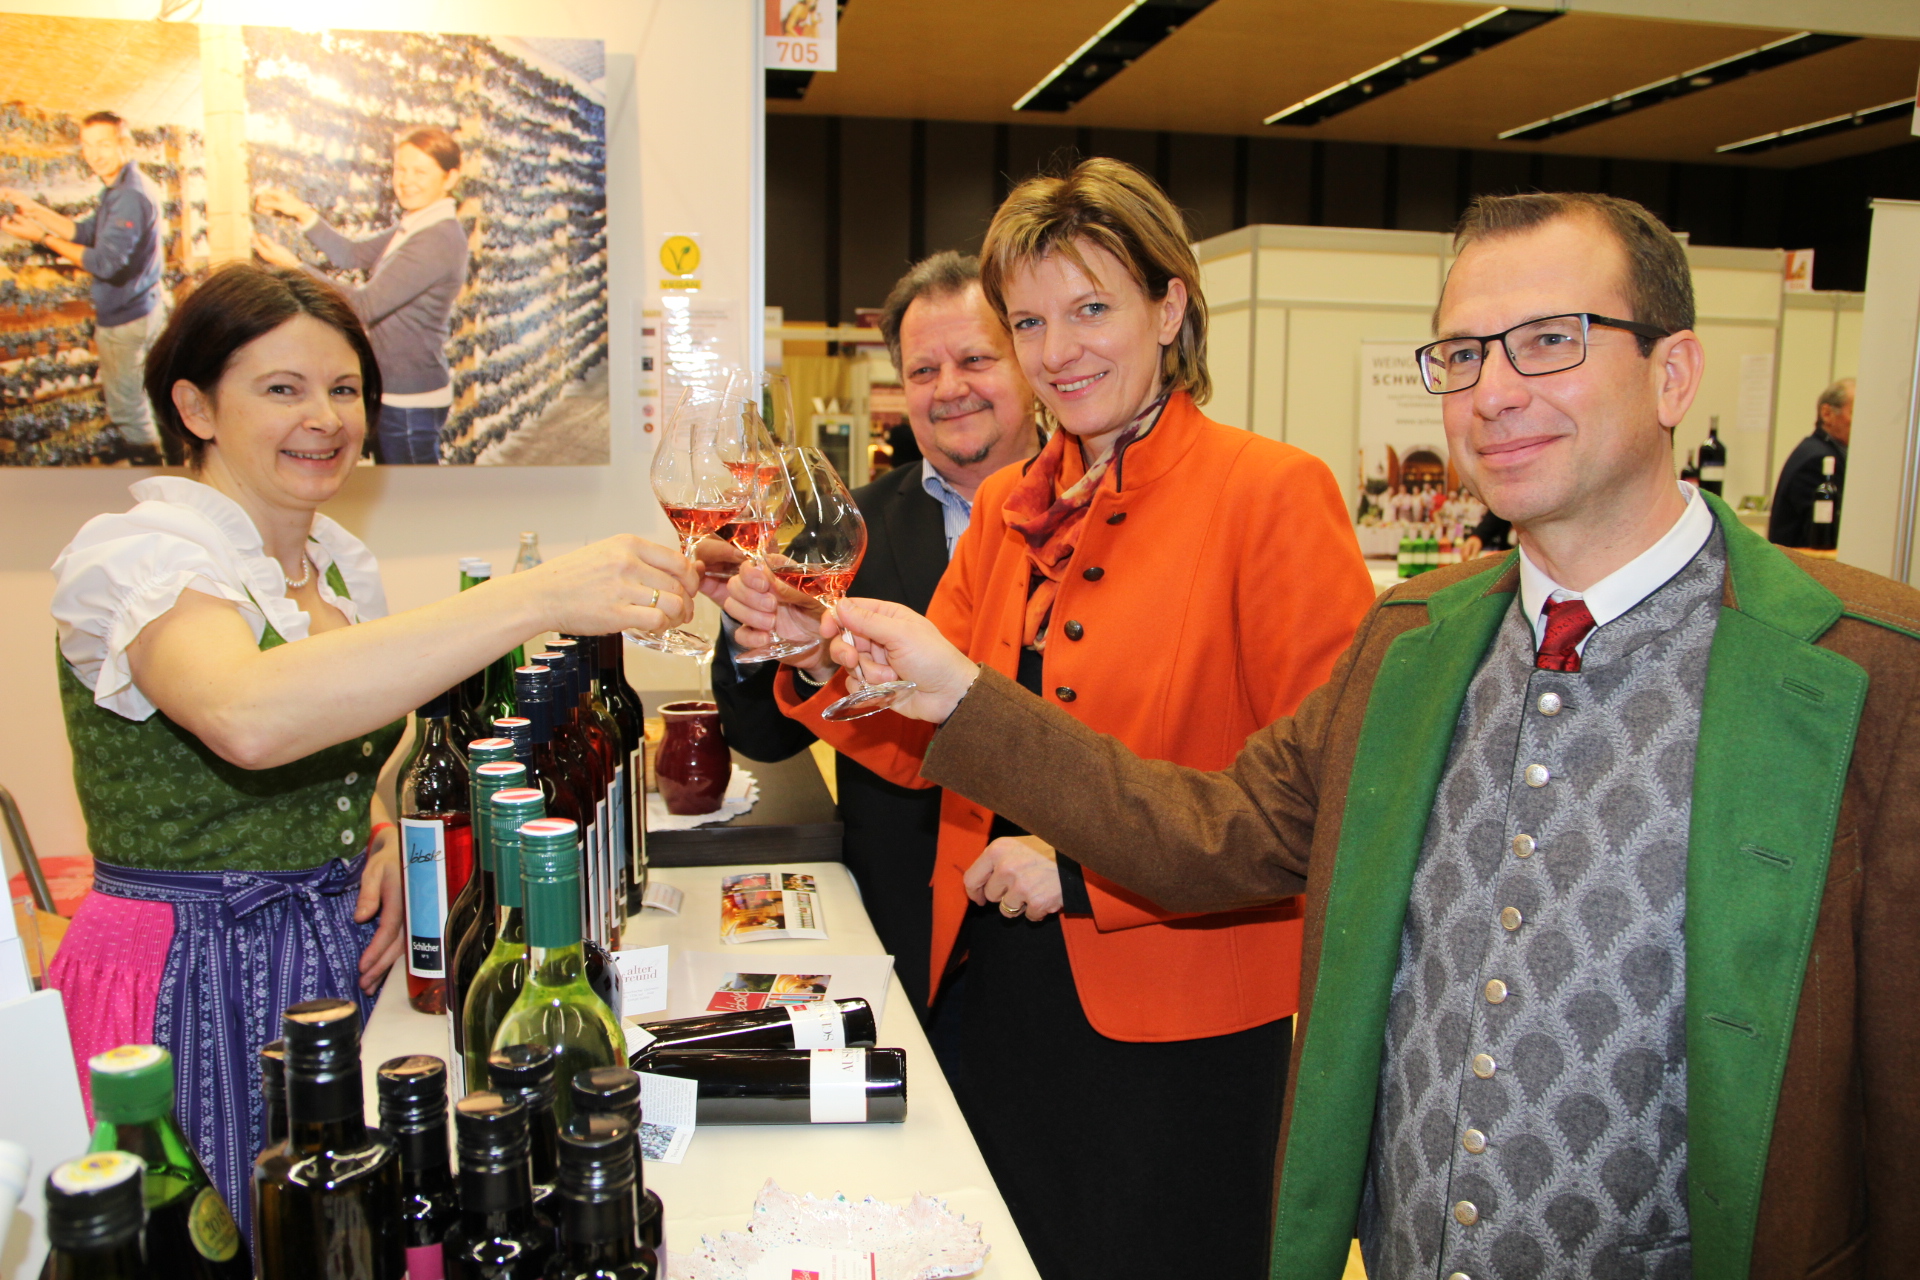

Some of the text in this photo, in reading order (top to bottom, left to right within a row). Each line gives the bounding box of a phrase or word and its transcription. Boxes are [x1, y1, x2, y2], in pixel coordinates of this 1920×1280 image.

[776, 41, 819, 64] 705
[1372, 356, 1417, 369] WEING
[412, 941, 439, 952] Schilcher
[627, 965, 653, 976] alter
